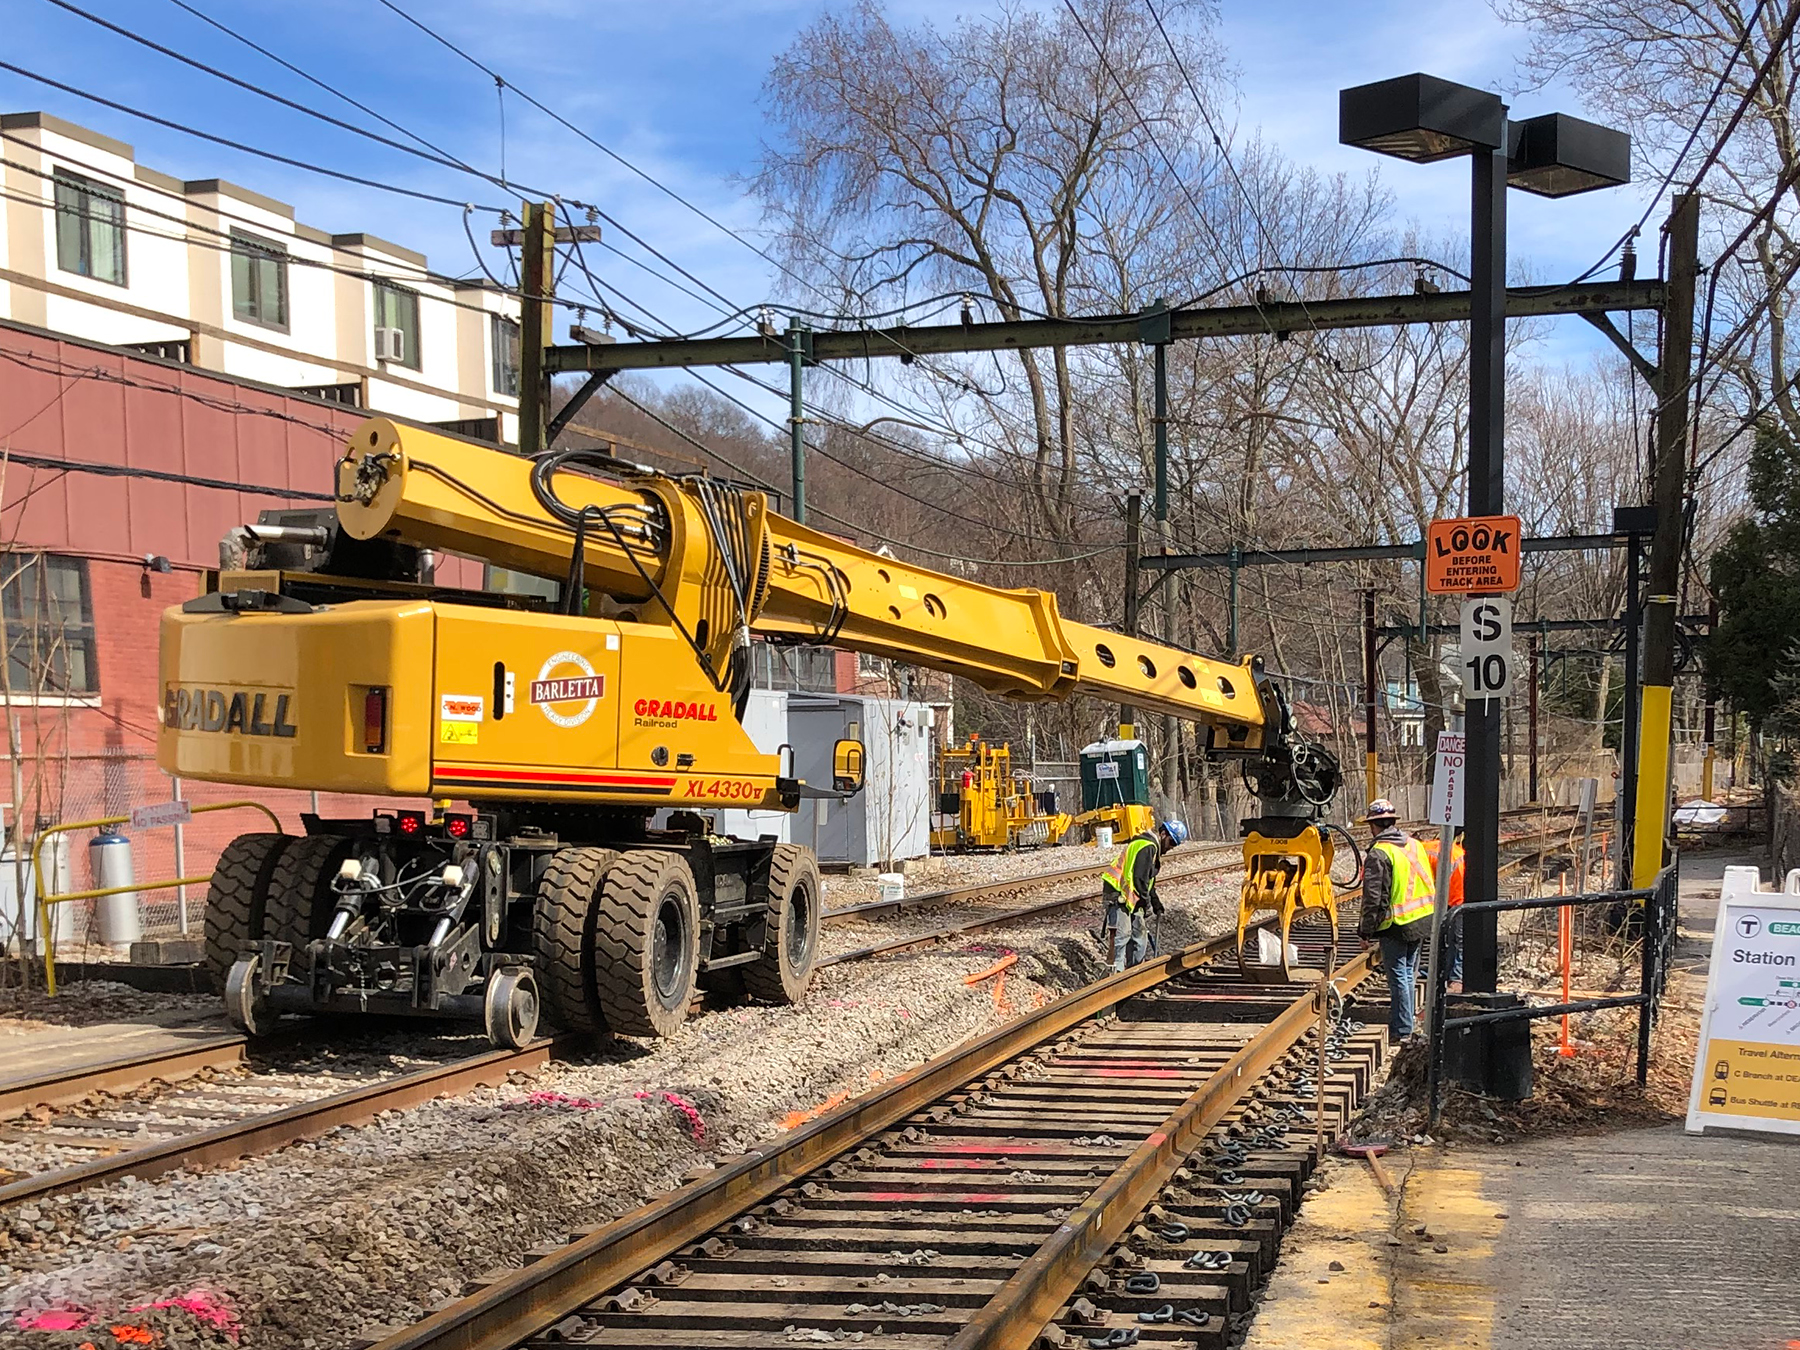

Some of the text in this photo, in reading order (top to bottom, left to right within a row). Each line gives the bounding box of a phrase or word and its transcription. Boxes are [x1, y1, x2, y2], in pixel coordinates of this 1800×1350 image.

[1435, 529, 1512, 558] LOOK
[1452, 555, 1491, 566] BEFORE
[1446, 566, 1497, 576] ENTERING
[1440, 576, 1503, 587] TRACK AREA
[1472, 605, 1502, 641] S
[1466, 654, 1506, 691] 10
[535, 678, 599, 701] BARLETTA
[165, 689, 297, 738] GRADALL
[634, 699, 718, 721] GRADALL
[634, 718, 678, 728] Railroad
[1443, 756, 1463, 768] NO
[1444, 769, 1456, 820] PASSING
[1741, 921, 1758, 935] T
[1732, 949, 1795, 966] Station
[1739, 1047, 1767, 1057] Travel
[1743, 1071, 1773, 1080] Branch
[1786, 1074, 1800, 1082] DE
[1730, 1096, 1746, 1105] Bus
[1748, 1098, 1778, 1107] Shuttle
